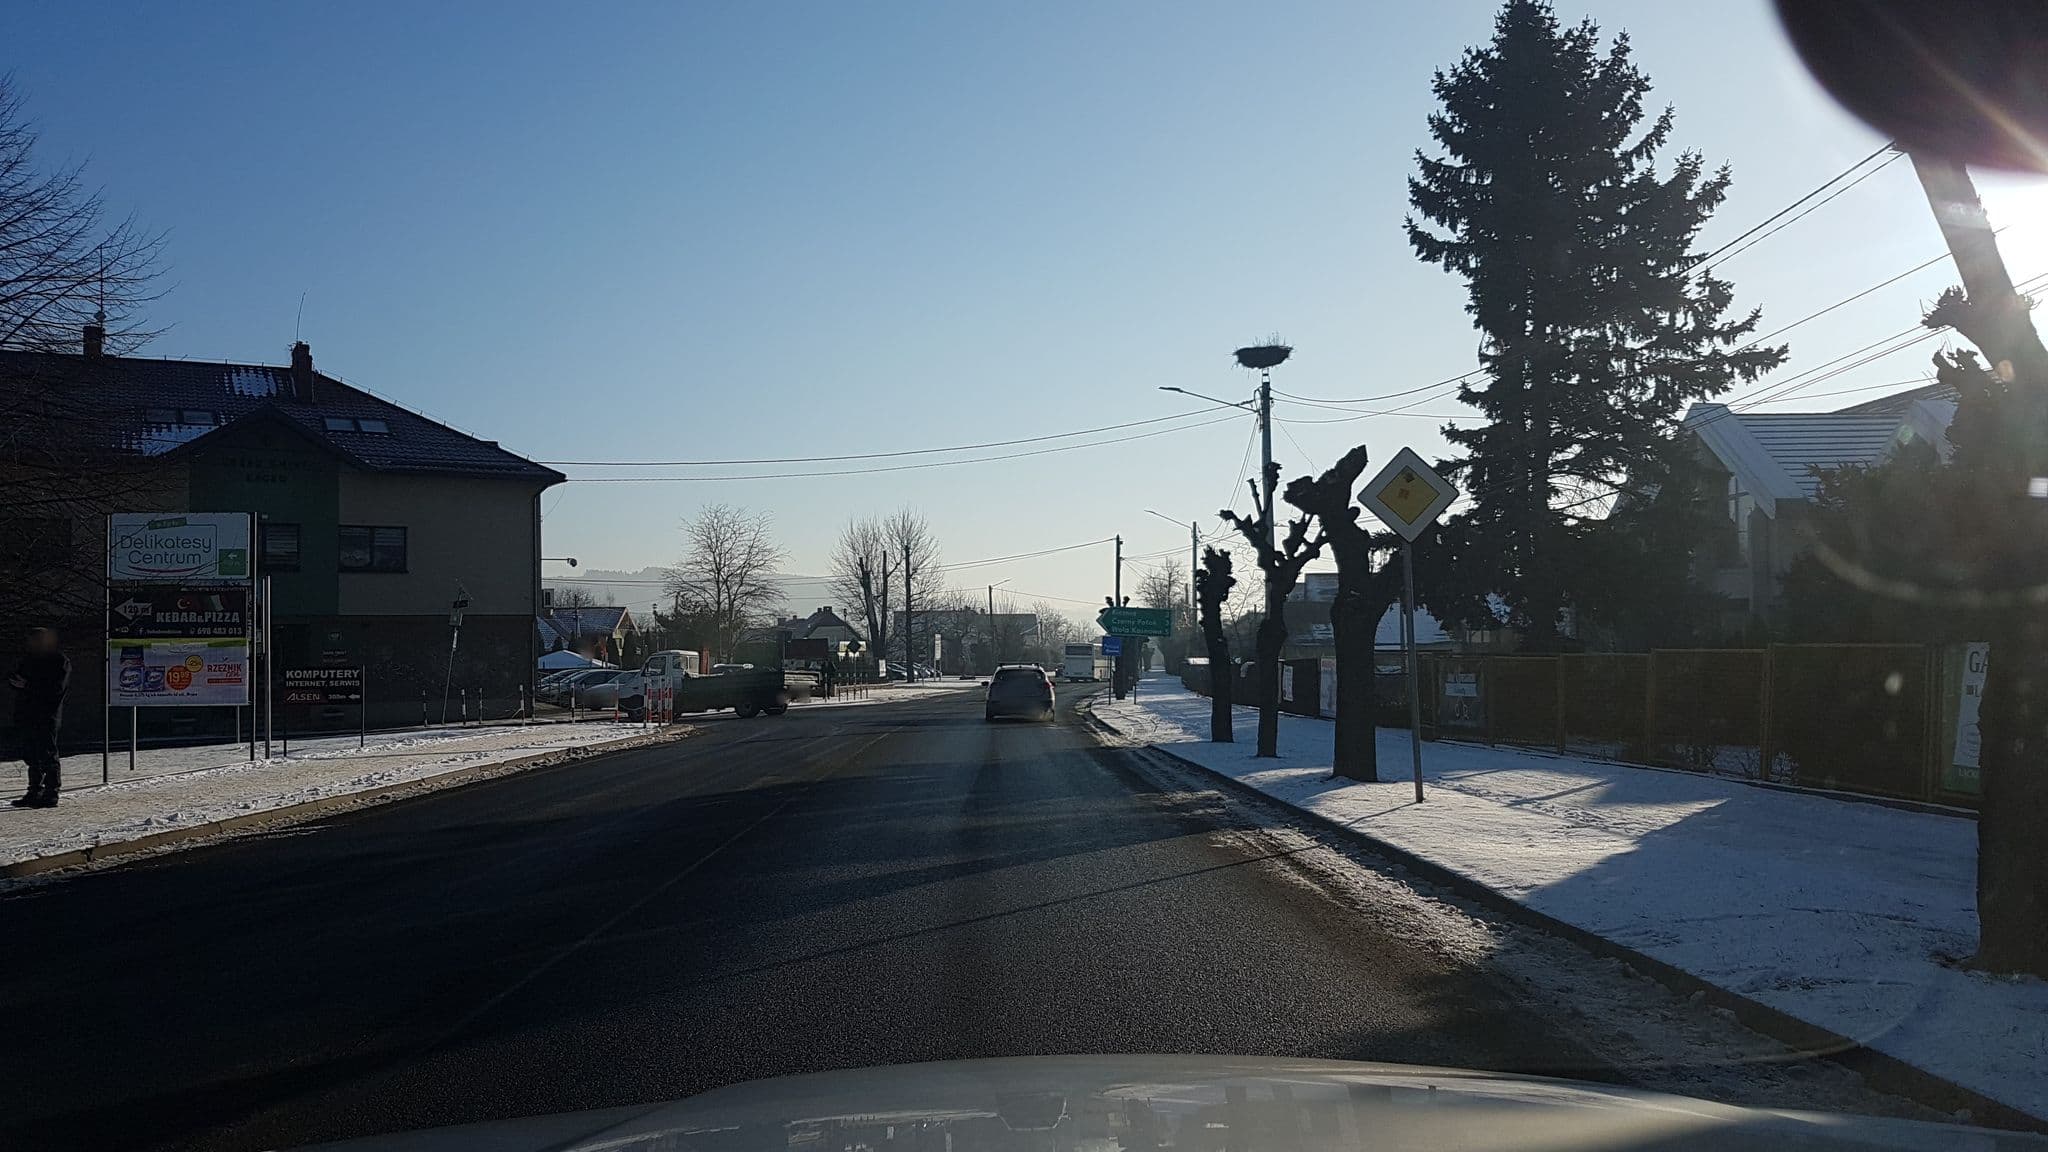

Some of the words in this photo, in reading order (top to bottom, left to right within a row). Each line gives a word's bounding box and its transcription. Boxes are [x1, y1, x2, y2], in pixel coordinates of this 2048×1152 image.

[120, 535, 211, 553] Delikatesy
[128, 550, 201, 564] Centrum
[286, 669, 361, 679] KOMPUTERY
[286, 692, 321, 701] ALSEN
